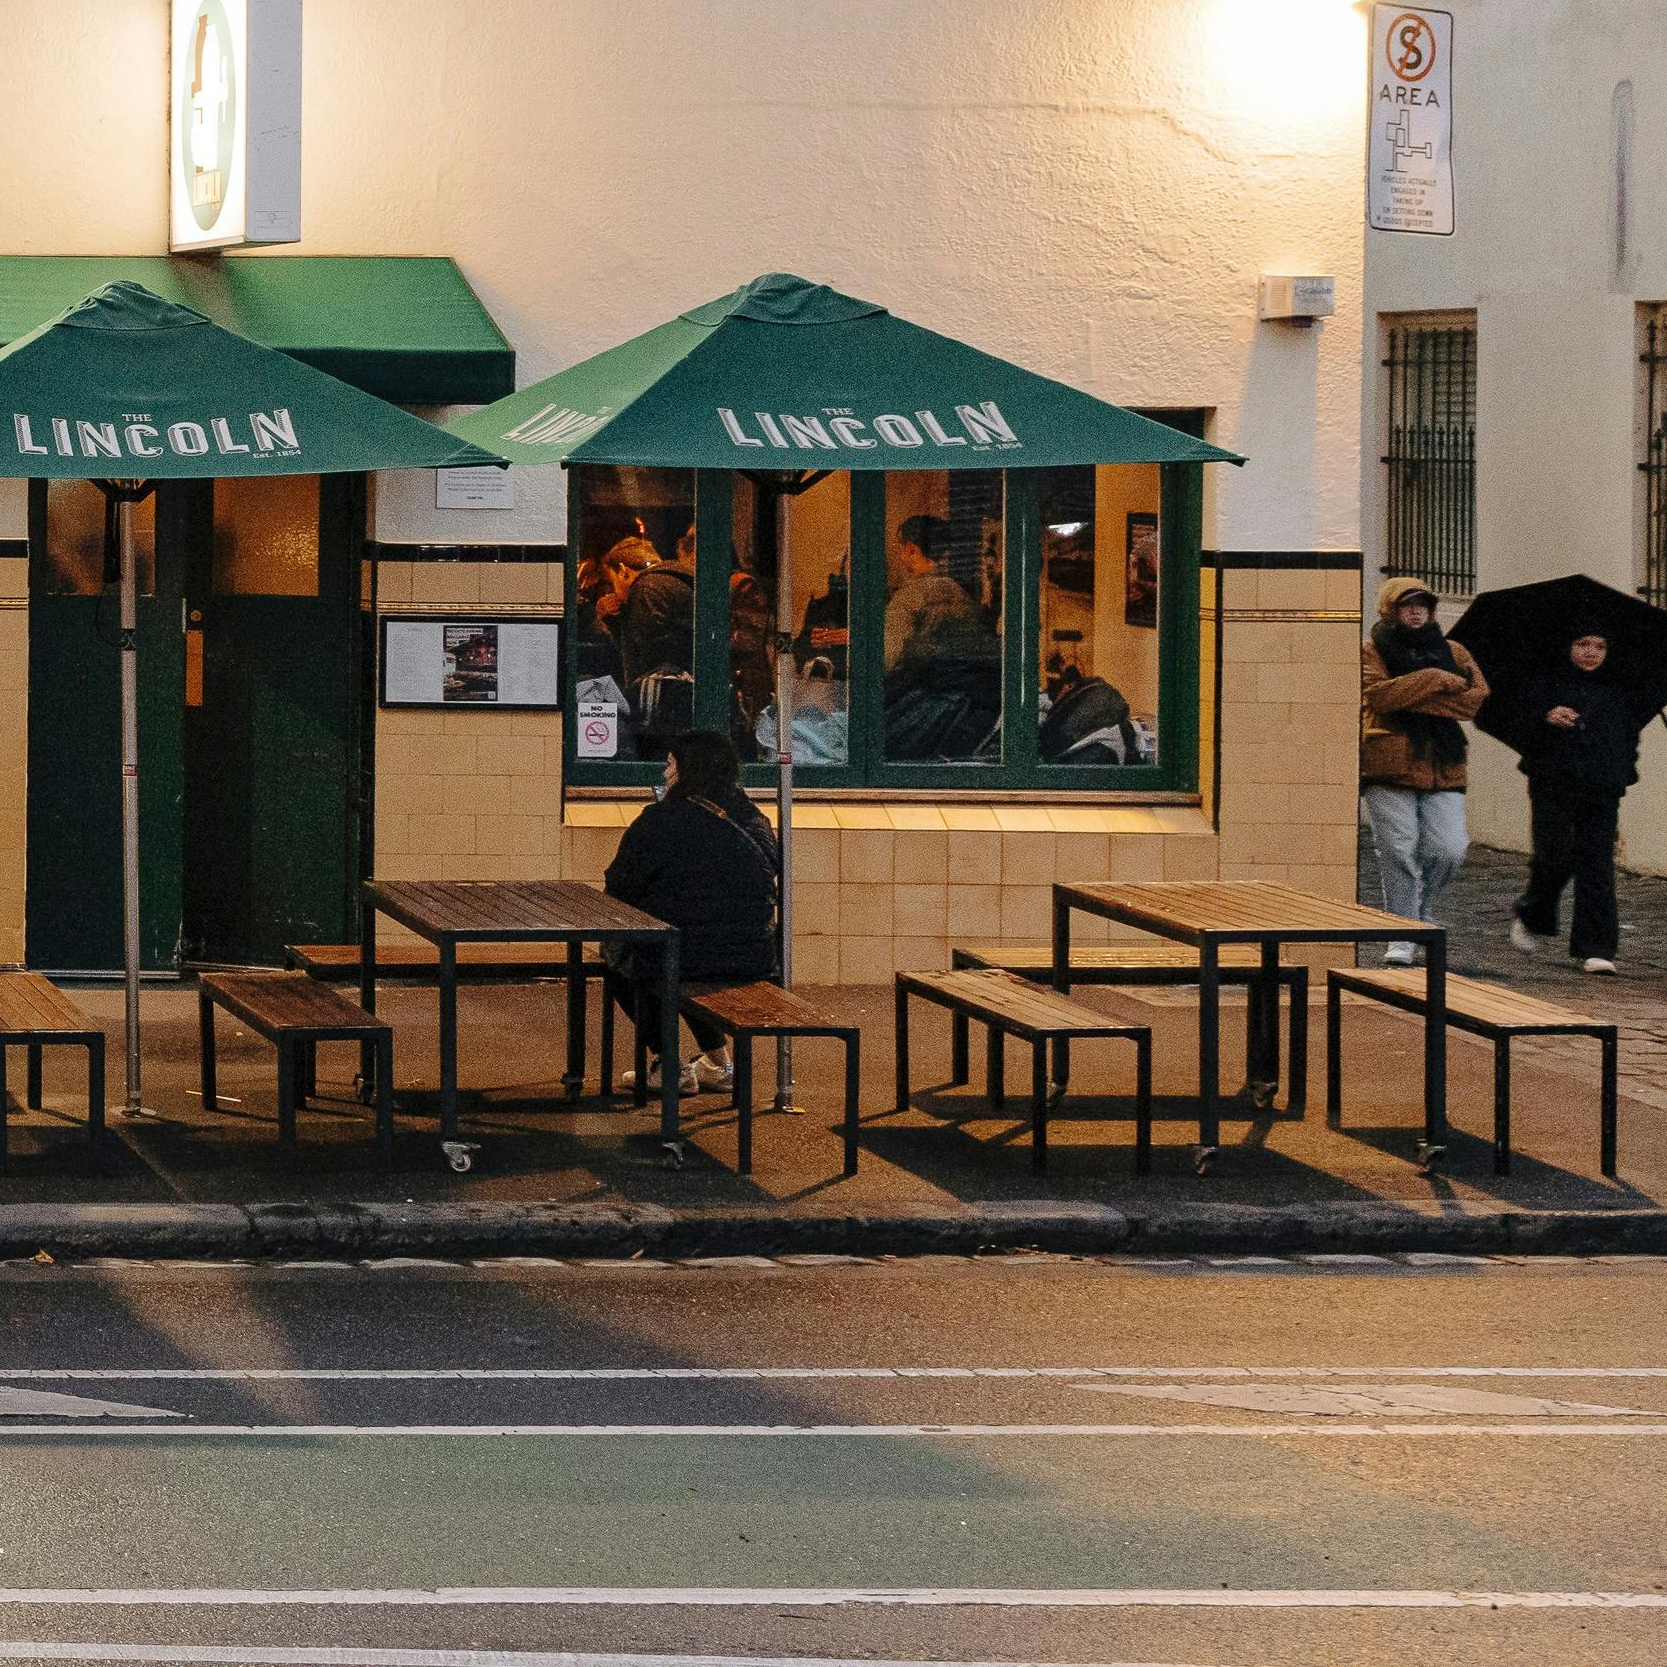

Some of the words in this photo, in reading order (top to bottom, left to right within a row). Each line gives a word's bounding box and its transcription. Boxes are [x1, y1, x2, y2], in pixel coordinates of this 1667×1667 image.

[1379, 84, 1440, 108] AREA
[122, 413, 152, 422] THE
[717, 401, 1018, 449] LINCOLN
[14, 408, 299, 458] LINCOLN
[277, 449, 301, 458] 1854
